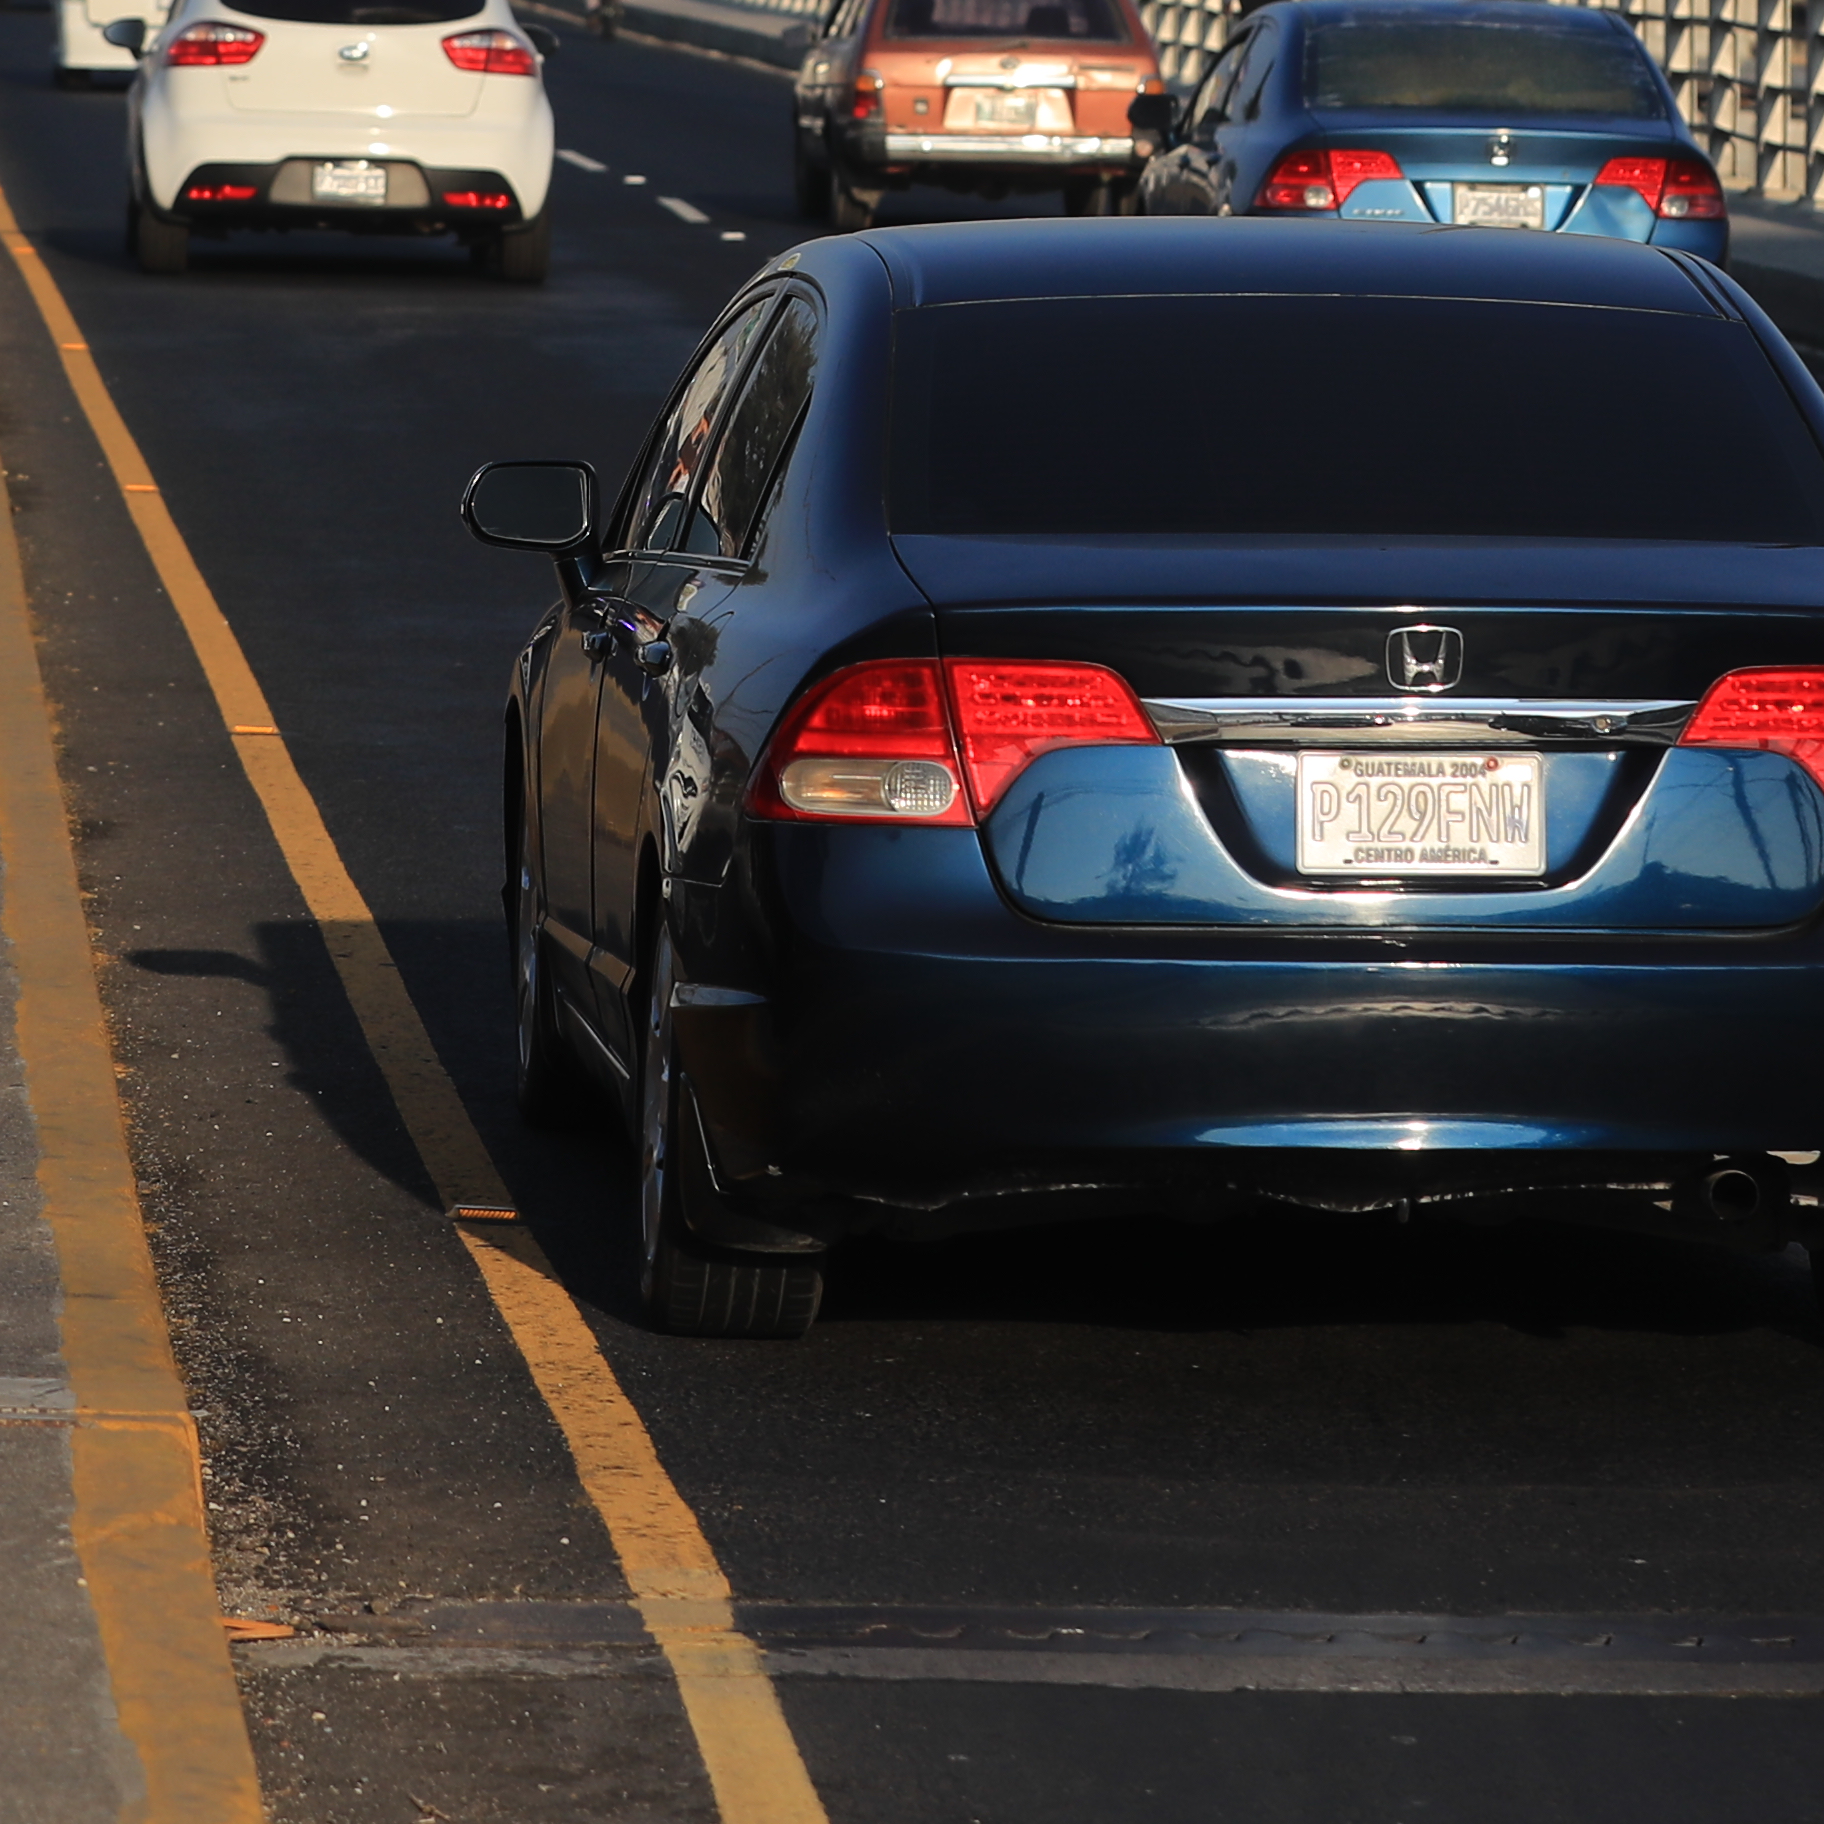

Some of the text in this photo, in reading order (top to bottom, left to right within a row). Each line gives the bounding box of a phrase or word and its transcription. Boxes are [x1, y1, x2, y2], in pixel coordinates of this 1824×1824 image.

[1353, 761, 1487, 778] GUATEMALA 2004
[1310, 781, 1532, 843] P129FNW
[1354, 845, 1489, 865] CENTRO AMÉRICA
